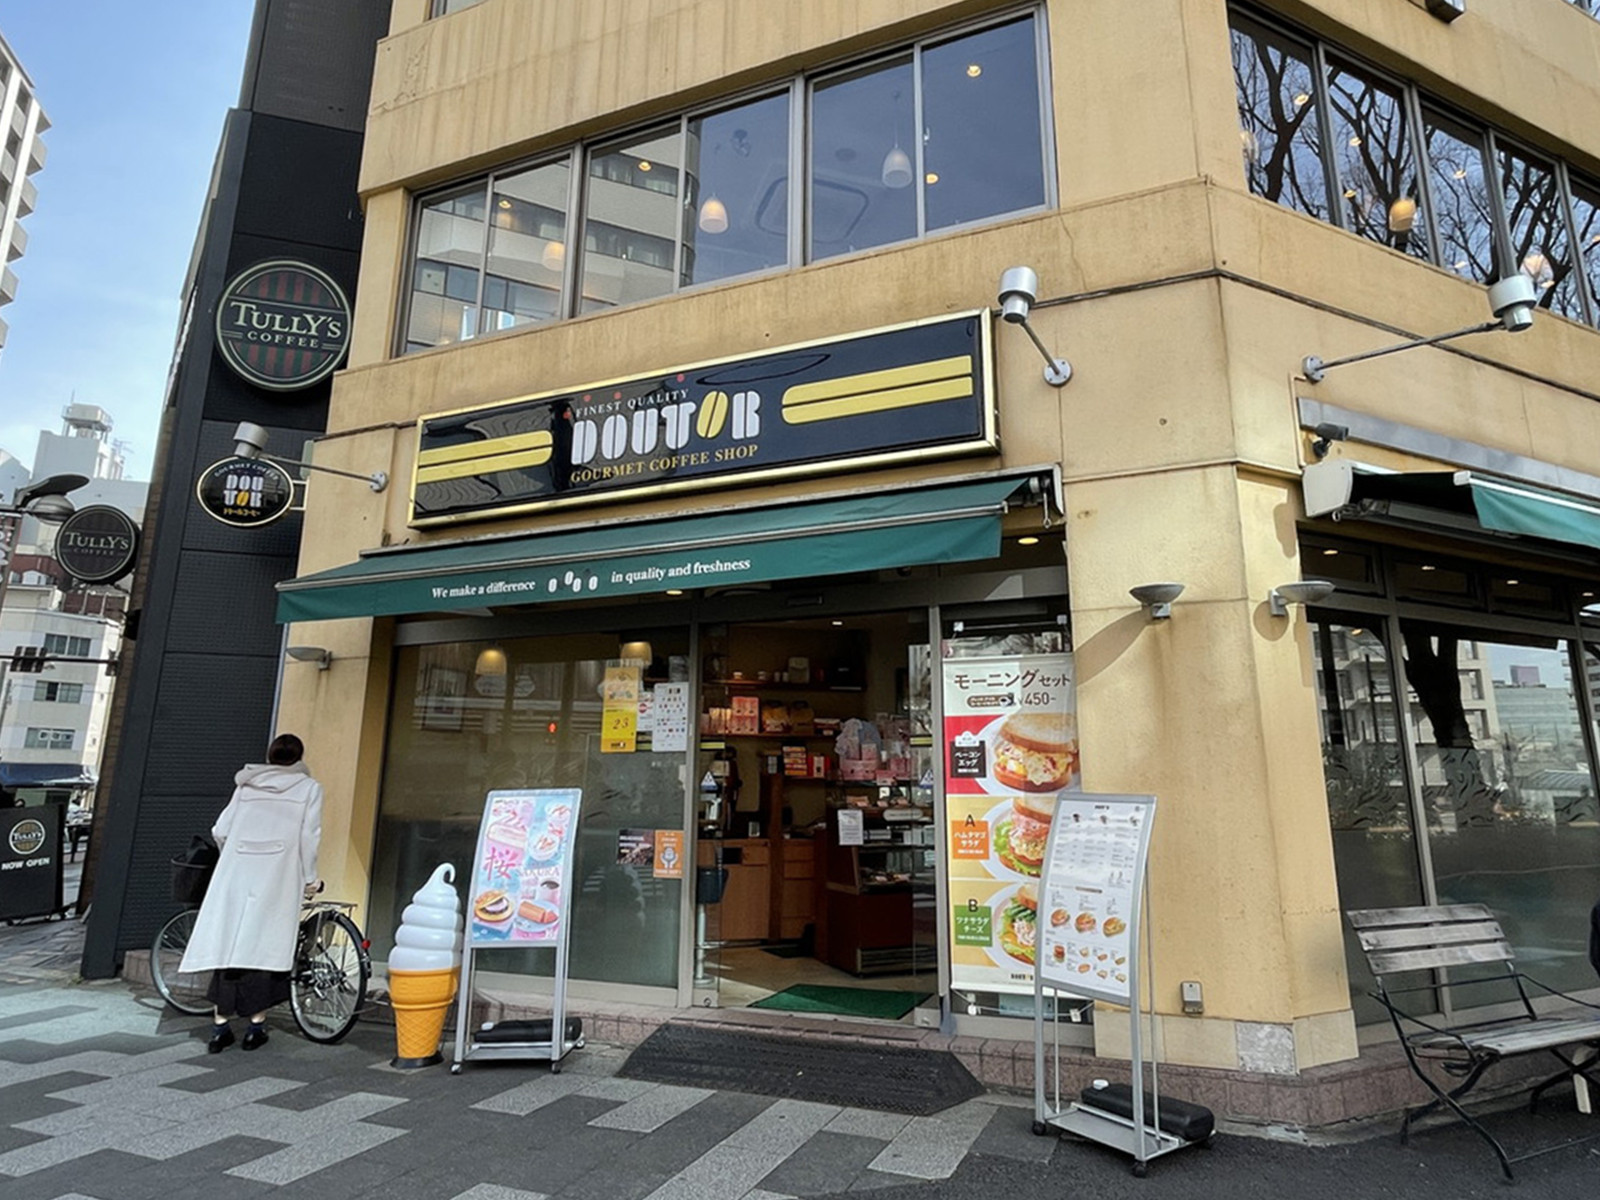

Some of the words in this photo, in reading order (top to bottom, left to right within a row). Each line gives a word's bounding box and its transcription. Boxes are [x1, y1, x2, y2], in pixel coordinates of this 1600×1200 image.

[230, 301, 342, 338] TULLY'S
[246, 330, 320, 349] COFFEE
[575, 401, 622, 419] FINEST
[627, 388, 690, 409] QUALITY
[570, 390, 761, 466] DOUTOR
[570, 461, 645, 483] GOURMET
[649, 451, 710, 472] COFFEE
[714, 444, 759, 462] SHOP
[65, 532, 129, 550] TULLY'S
[432, 587, 448, 598] We
[449, 585, 477, 597] make
[478, 586, 484, 595] a
[486, 581, 536, 595] difference
[611, 571, 623, 583] in
[625, 566, 666, 584] quality
[668, 563, 691, 577] and
[694, 559, 751, 574] freshness
[954, 668, 1071, 690] モーニングセット
[964, 814, 976, 828] A
[1, 861, 24, 871] NOW
[26, 857, 50, 867] OPEN
[968, 898, 978, 913] B
